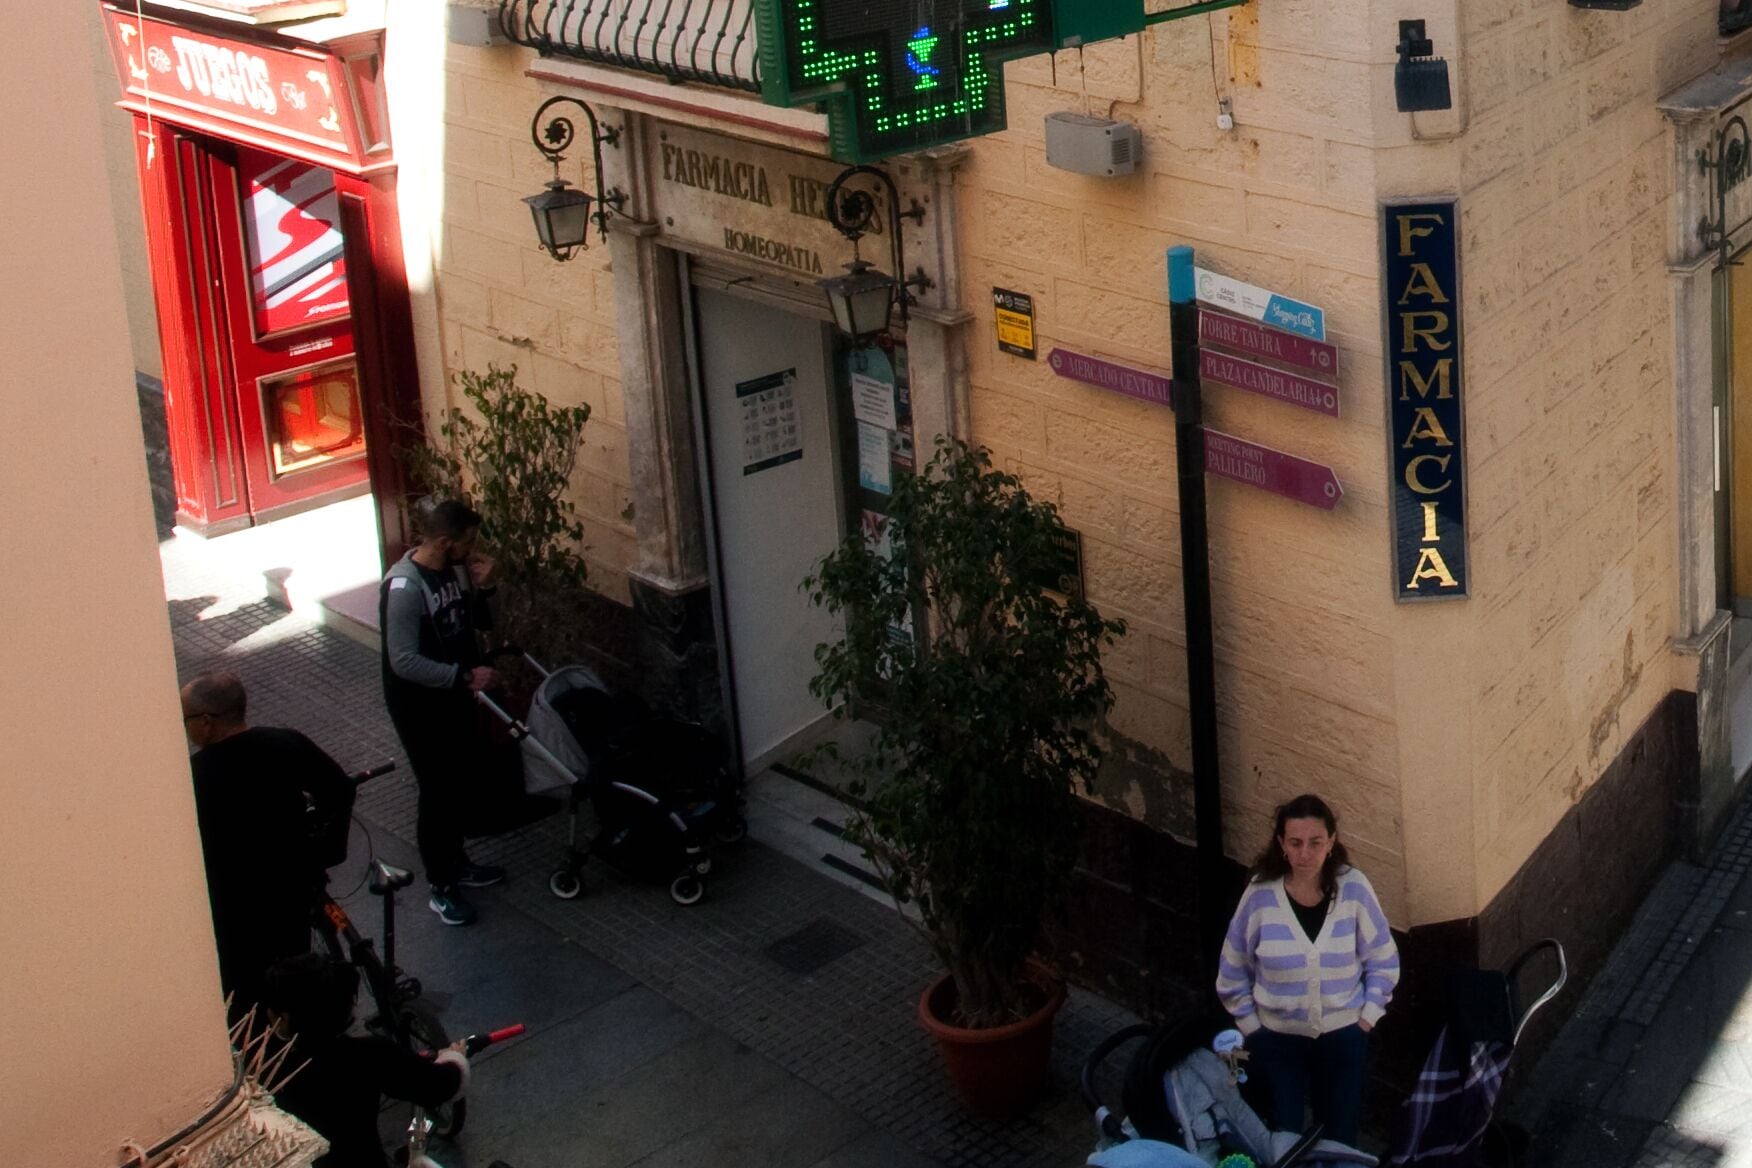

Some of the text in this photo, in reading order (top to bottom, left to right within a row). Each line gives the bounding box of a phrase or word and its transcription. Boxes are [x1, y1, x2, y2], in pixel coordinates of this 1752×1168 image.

[171, 35, 277, 116] JUEGOS
[661, 141, 772, 208] FARMACIA
[723, 227, 823, 275] HOMEOPATIA
[1202, 316, 1283, 356] TORRE TAVIRA
[1068, 357, 1169, 401] MERCADO CENTRAL
[1205, 356, 1318, 407] PLAZA CANDELARIA
[1396, 213, 1458, 590] FARMACIA
[1207, 450, 1266, 486] PALILLERO
